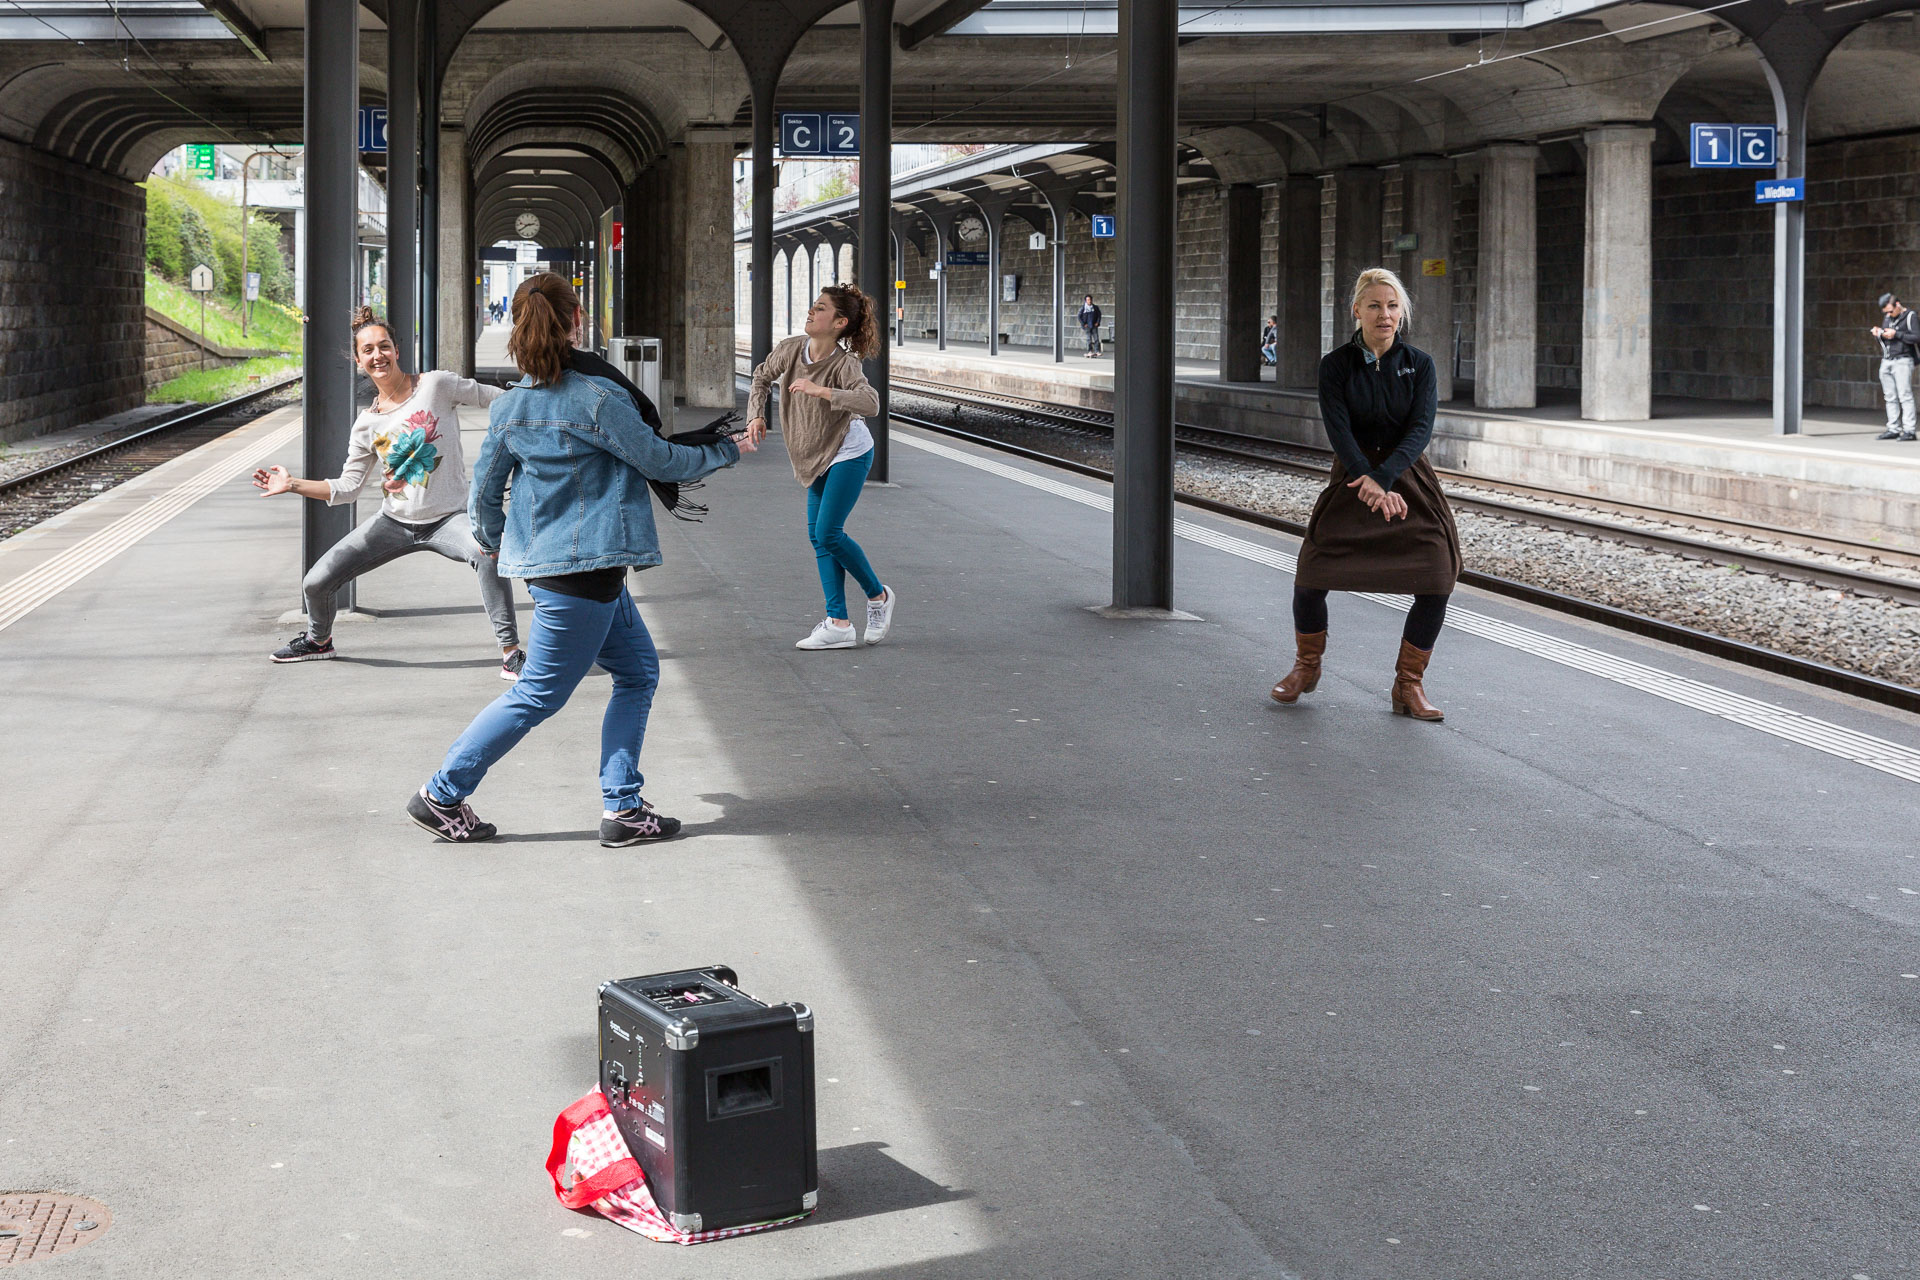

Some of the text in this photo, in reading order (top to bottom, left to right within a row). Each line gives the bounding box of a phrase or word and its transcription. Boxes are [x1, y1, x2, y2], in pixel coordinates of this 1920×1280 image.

[793, 126, 811, 148] C
[838, 126, 855, 148] 2
[1708, 137, 1718, 160] 1
[1747, 138, 1766, 161] C
[1100, 221, 1108, 234] 1
[1035, 235, 1040, 248] 1
[199, 271, 204, 288] 1
